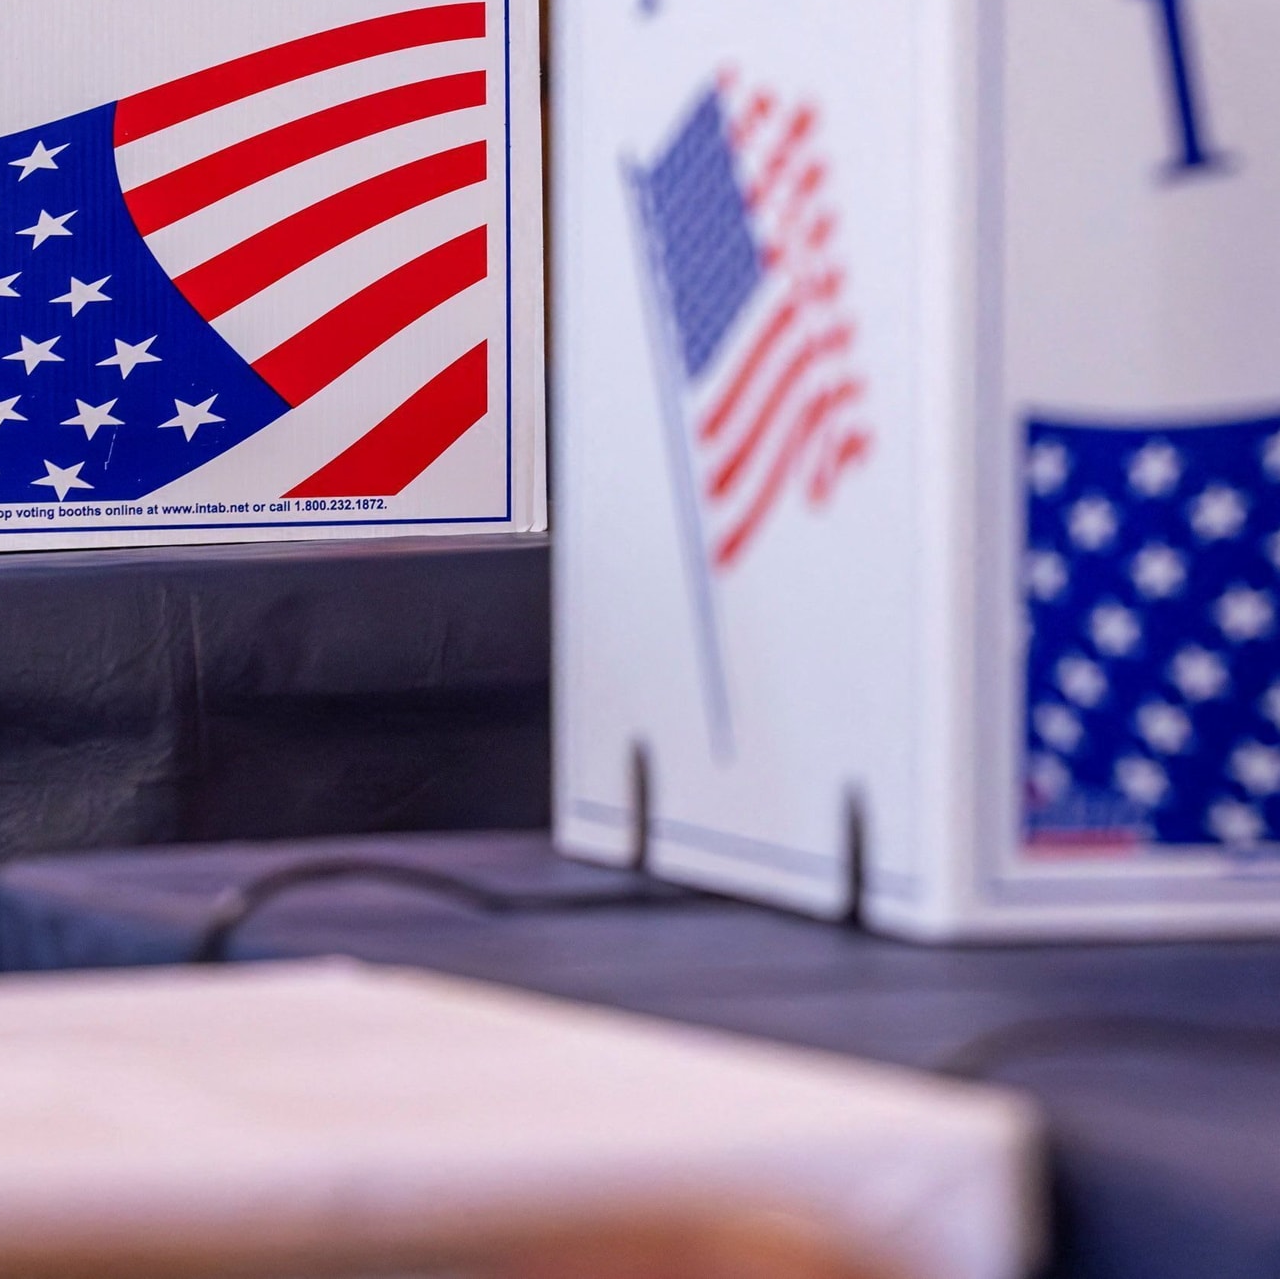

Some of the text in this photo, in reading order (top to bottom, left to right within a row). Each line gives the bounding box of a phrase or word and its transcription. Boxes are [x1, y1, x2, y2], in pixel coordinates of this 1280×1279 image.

[15, 506, 55, 521] voting
[58, 505, 102, 518] booths
[104, 504, 144, 516] online
[146, 504, 159, 515] at
[161, 502, 250, 515] www.intab.net
[252, 503, 267, 513] or
[268, 500, 291, 513] call
[294, 498, 388, 512] 1.800.232.1872.
